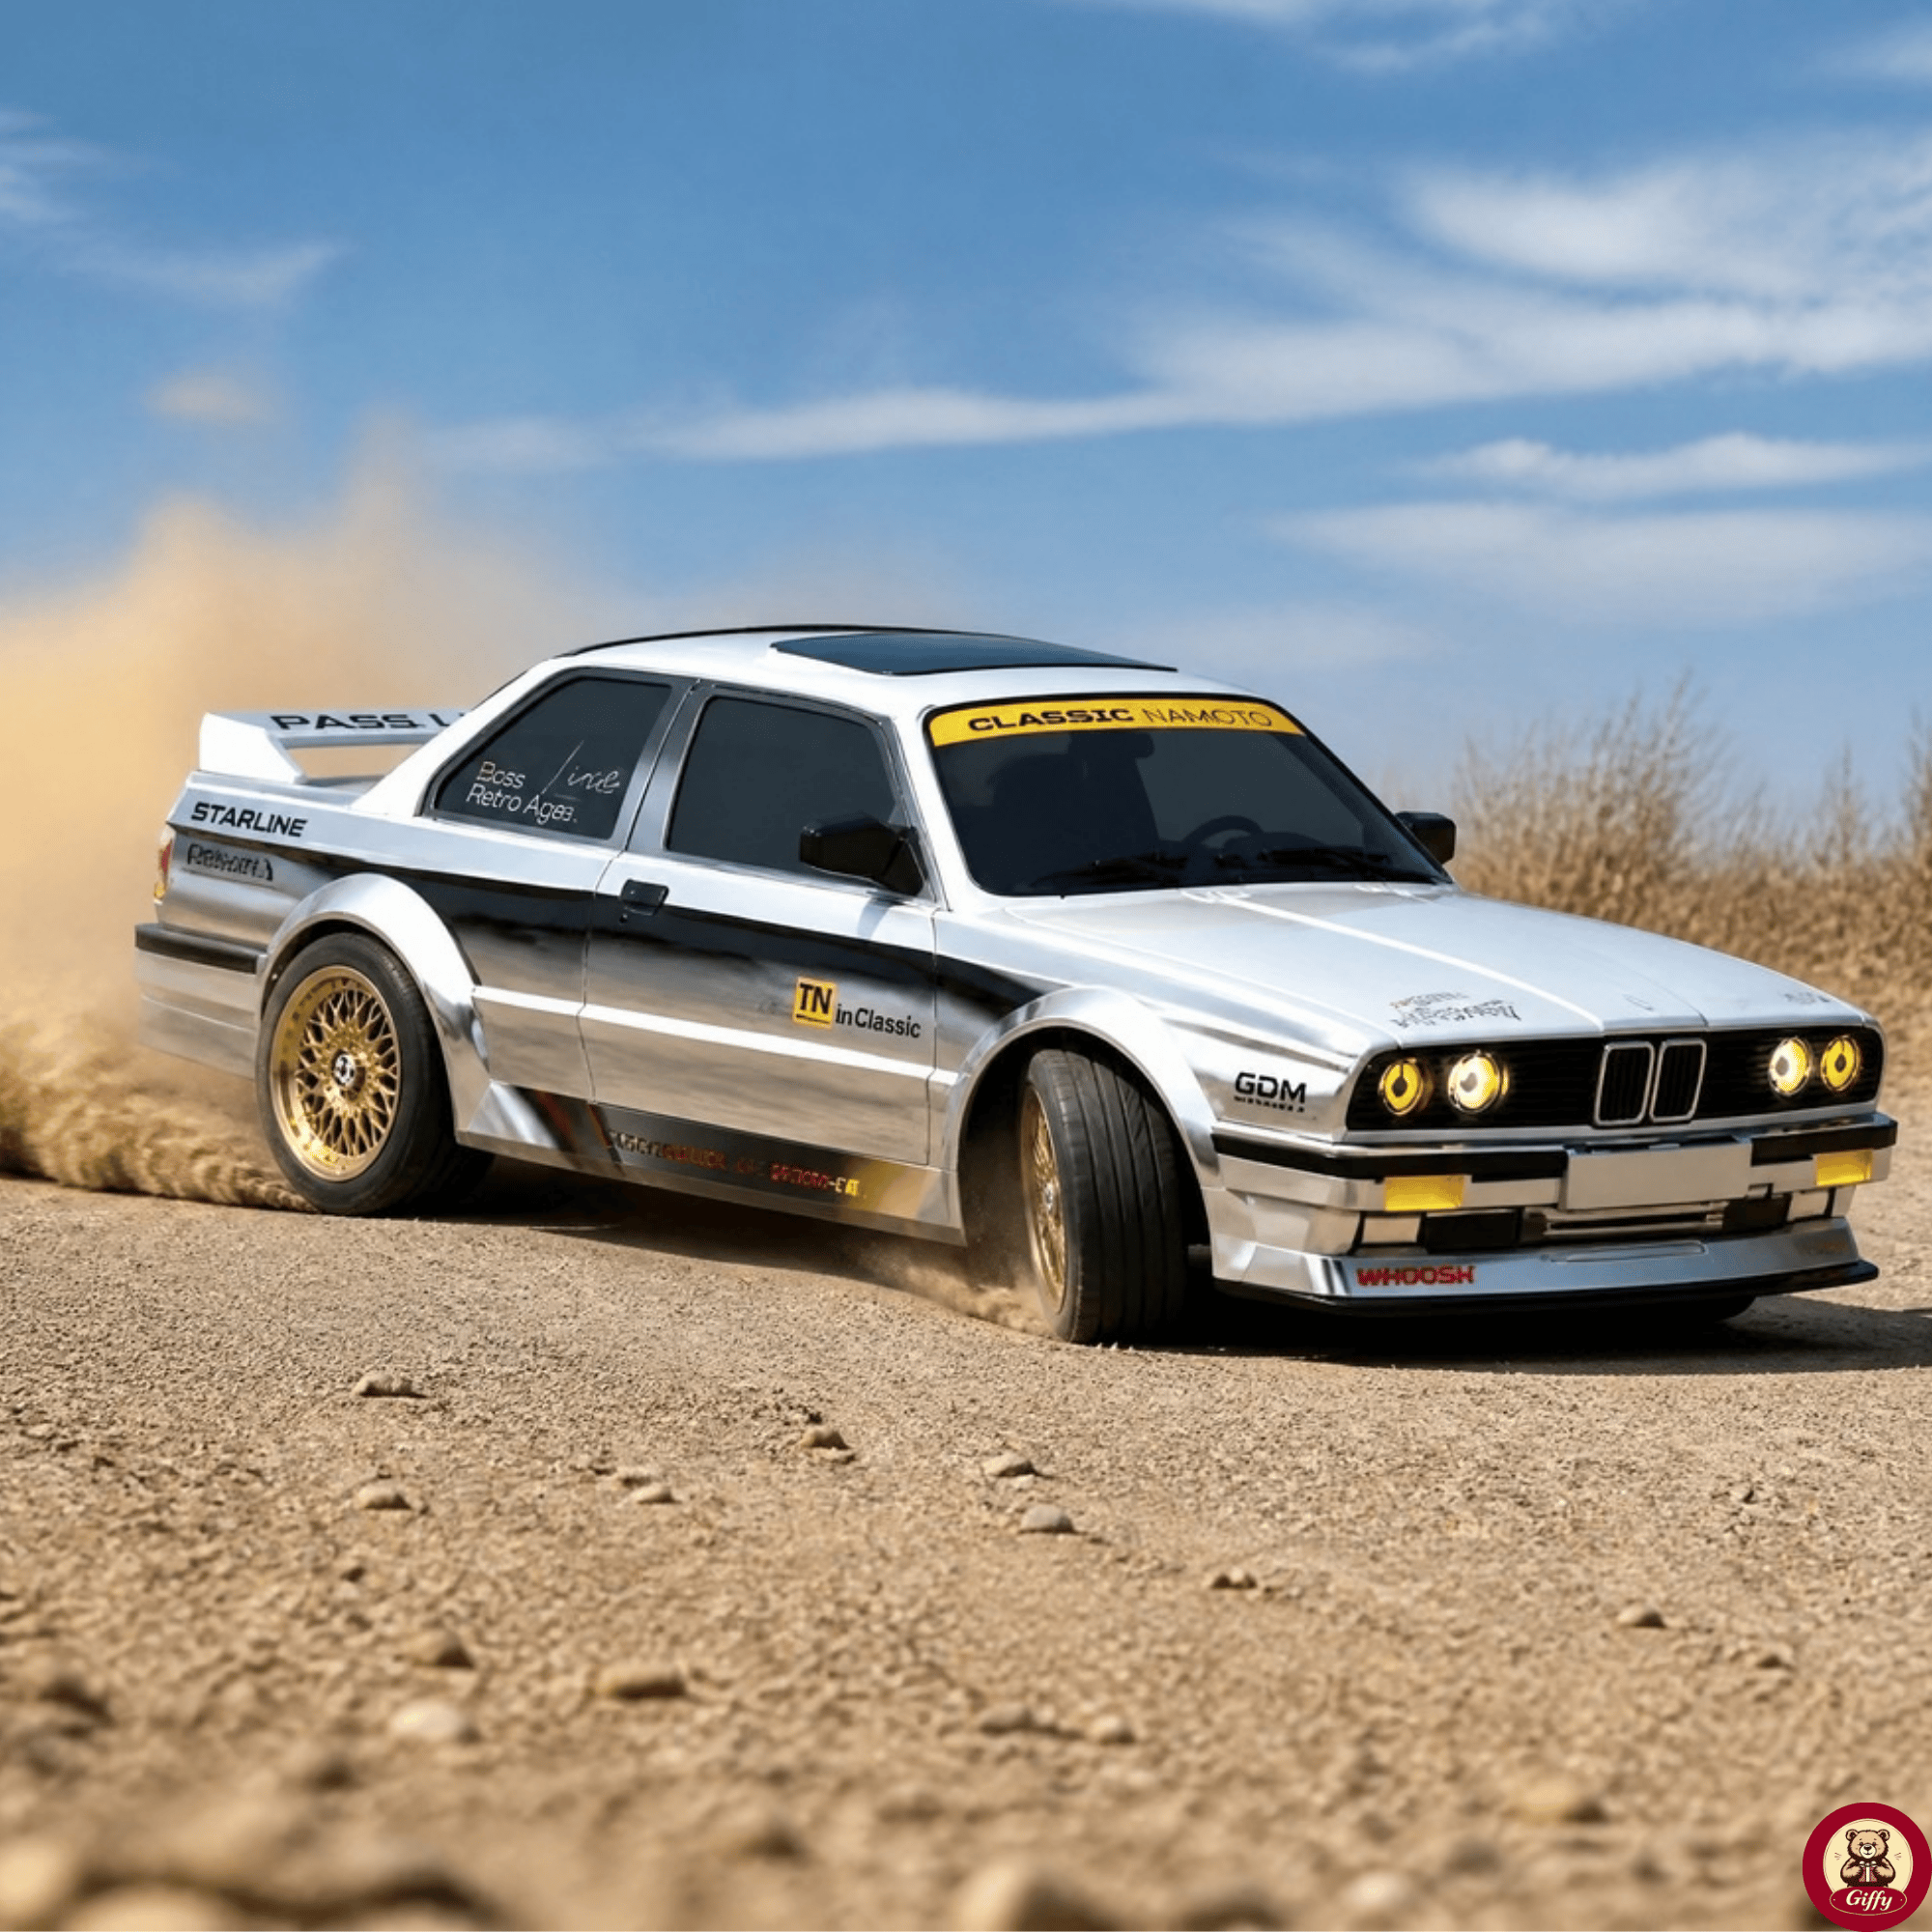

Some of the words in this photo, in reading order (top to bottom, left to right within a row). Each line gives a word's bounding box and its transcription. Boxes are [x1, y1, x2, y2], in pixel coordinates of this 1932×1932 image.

[270, 714, 419, 729] PASS
[968, 708, 1134, 731] CLASSIC
[1142, 708, 1272, 726] NAMOTO
[466, 782, 522, 811] Retro
[191, 801, 308, 838] STARLINE
[800, 981, 833, 1014] TN
[1235, 1071, 1307, 1104] GDM
[1357, 1264, 1475, 1286] WHOOSH
